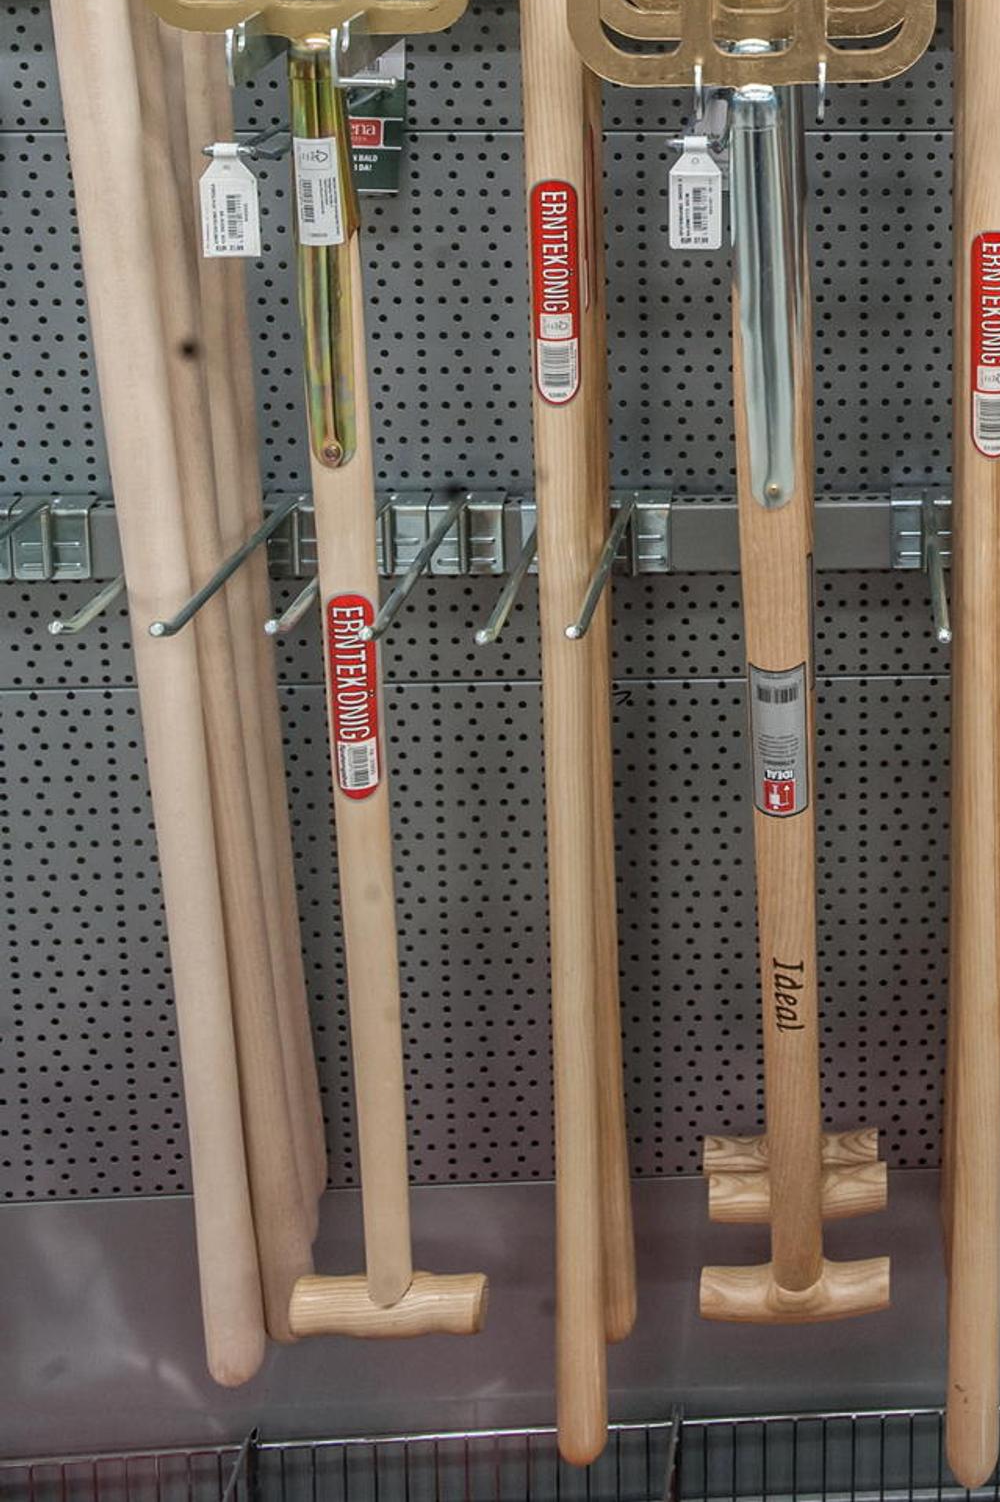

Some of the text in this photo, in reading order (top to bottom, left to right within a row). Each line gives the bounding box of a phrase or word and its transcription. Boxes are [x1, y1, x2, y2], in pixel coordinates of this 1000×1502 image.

[540, 190, 573, 313] ERNTEKÖNIG
[332, 605, 375, 740] ERNTEKÖNIG
[766, 769, 794, 780] IDEAL
[772, 956, 806, 1034] Ideal
